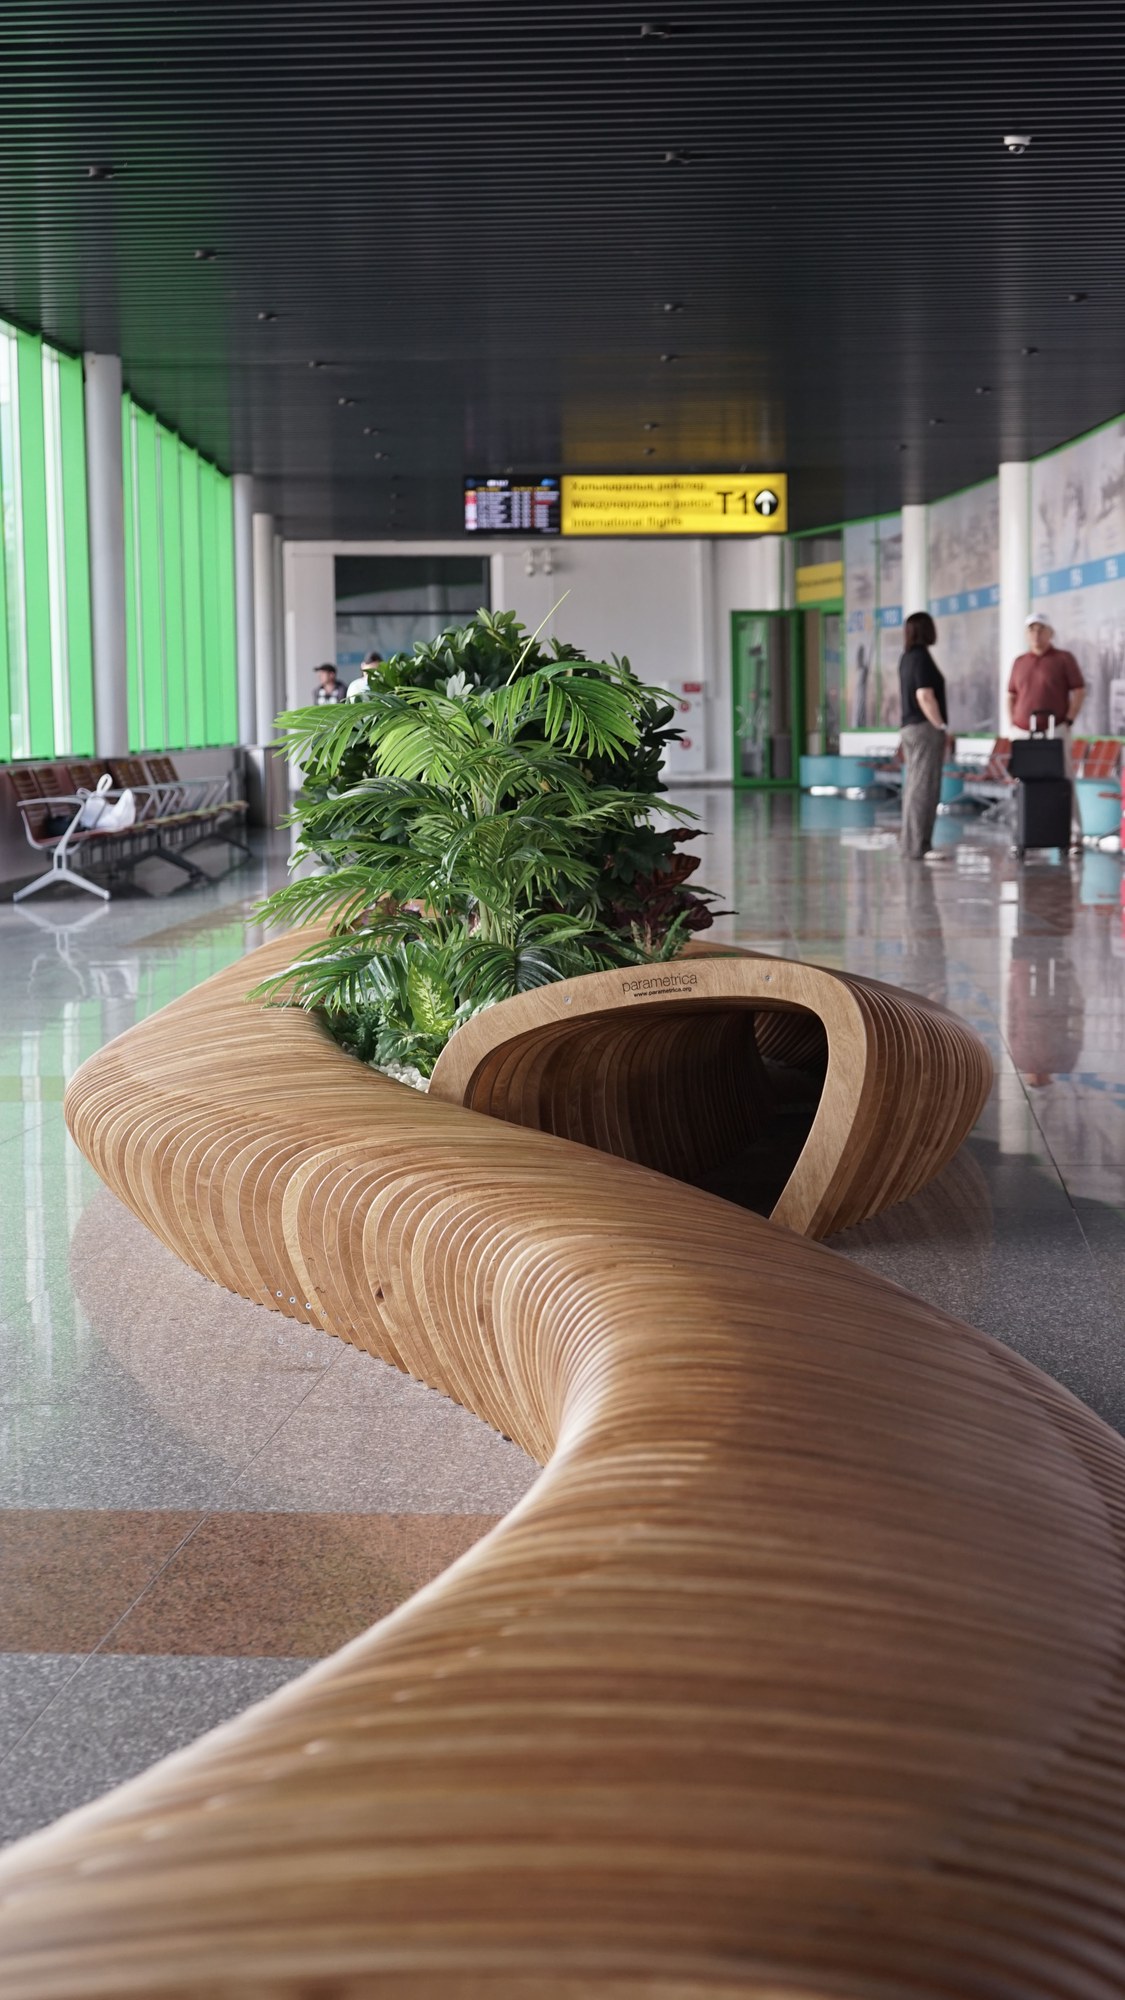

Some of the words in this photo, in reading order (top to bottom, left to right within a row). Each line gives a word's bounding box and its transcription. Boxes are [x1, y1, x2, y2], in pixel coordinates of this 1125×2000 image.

[715, 491, 747, 515] T1
[573, 517, 642, 528] International
[646, 516, 682, 529] flights
[622, 973, 698, 995] parametrica
[633, 986, 692, 997] www.parametrica.org
